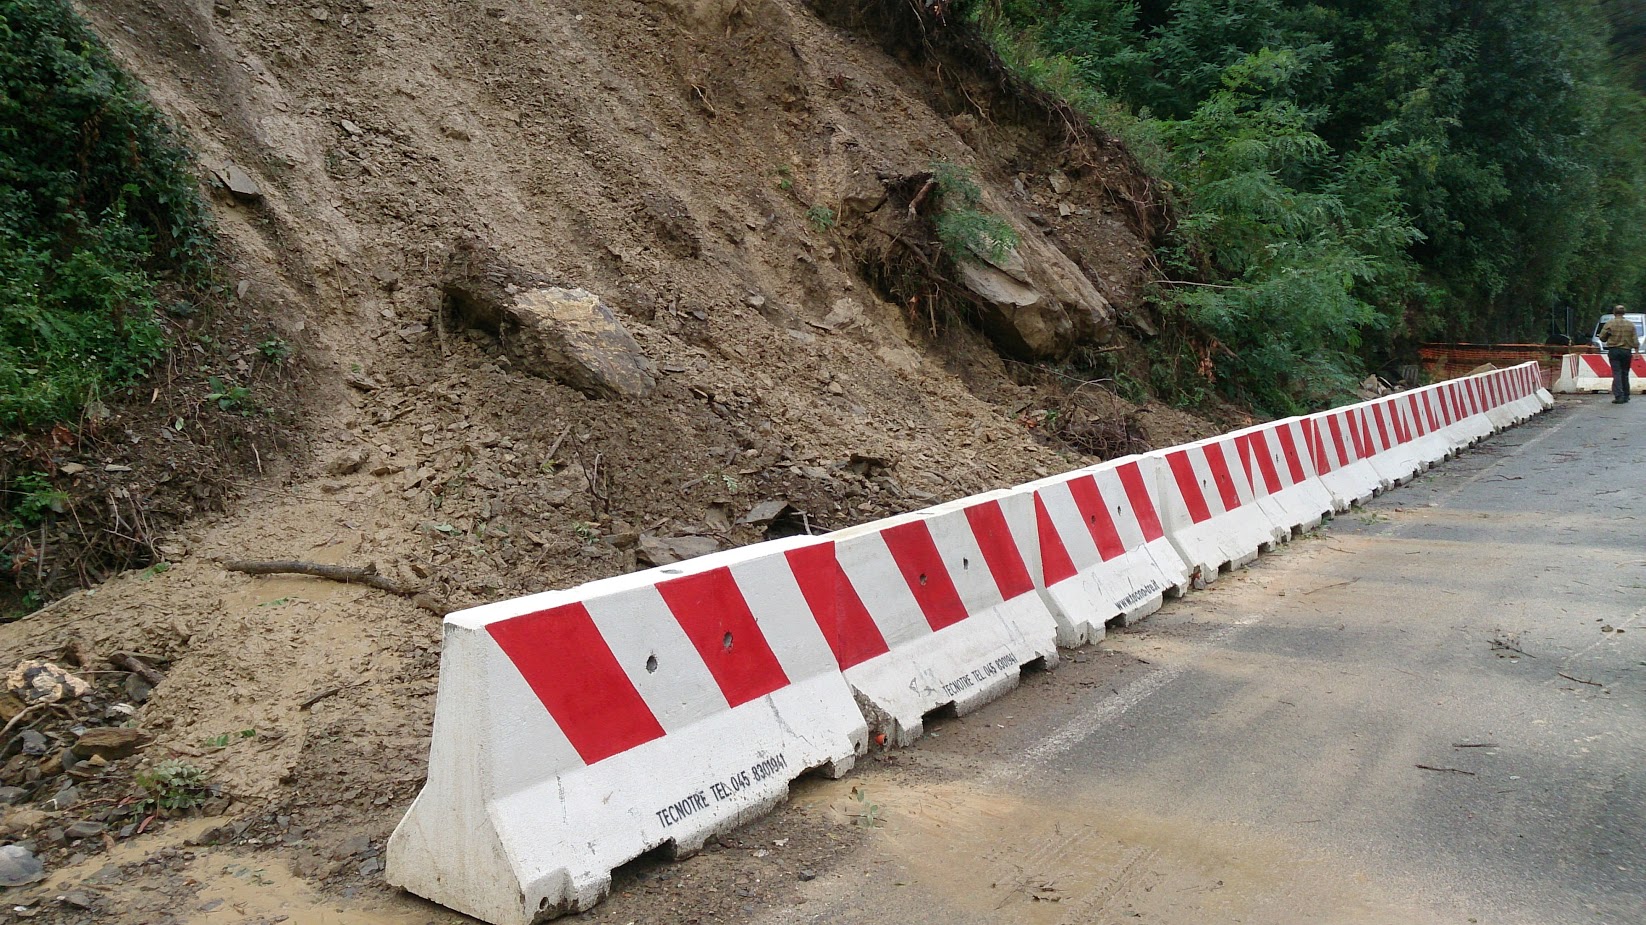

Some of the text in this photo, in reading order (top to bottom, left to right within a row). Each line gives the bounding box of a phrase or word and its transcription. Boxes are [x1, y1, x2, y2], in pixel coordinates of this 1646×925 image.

[942, 674, 974, 697] TECNOTRE
[982, 662, 997, 677] 045
[995, 652, 1018, 671] 8301941
[656, 753, 787, 828] TECNOTRE TEL. 045 8301941
